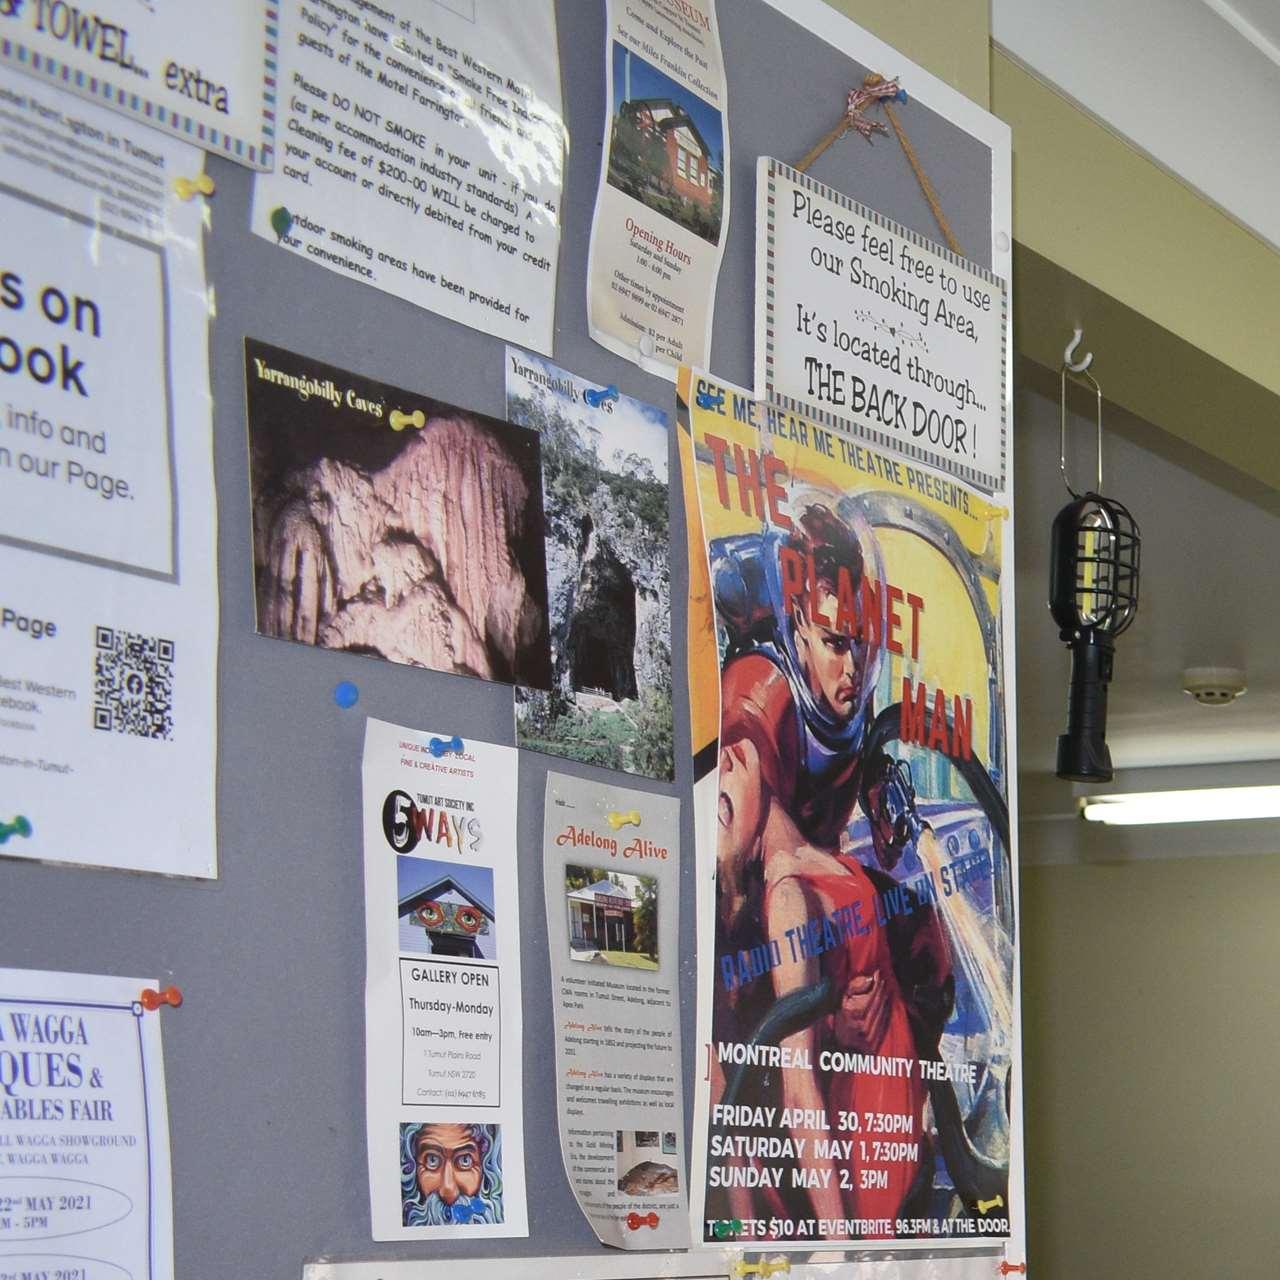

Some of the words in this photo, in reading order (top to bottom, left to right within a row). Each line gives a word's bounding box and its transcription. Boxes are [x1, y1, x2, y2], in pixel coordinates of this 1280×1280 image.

[166, 62, 229, 115] extra
[294, 72, 328, 101] Please
[332, 92, 350, 111] DO
[355, 104, 381, 126] NOT
[385, 121, 426, 149] SMOKE
[449, 153, 470, 169] your
[479, 168, 497, 183] unit
[285, 143, 310, 160] your
[315, 158, 356, 182] account
[362, 179, 374, 189] or
[378, 184, 420, 214] directly
[425, 205, 464, 231] debited
[469, 224, 492, 245] from
[496, 239, 517, 256] your
[523, 251, 551, 271] credit
[625, 218, 664, 252] Opening
[666, 239, 692, 265] Hours
[793, 190, 855, 244] Please
[862, 225, 894, 265] feel
[900, 246, 934, 283] free
[939, 268, 957, 295] to
[963, 284, 991, 312] use
[330, 230, 373, 259] smoking
[378, 250, 408, 272] areas
[412, 263, 436, 283] have
[440, 277, 464, 296] been
[469, 290, 510, 316] provided
[515, 308, 530, 324] for
[811, 247, 843, 275] our
[850, 256, 930, 326] Smoking
[935, 300, 979, 344] Area,
[41, 286, 101, 338] on
[511, 356, 581, 403] Yarrangobilly
[796, 303, 827, 343] It's
[834, 321, 901, 375] located
[907, 356, 986, 411] through...
[254, 358, 343, 408] Yarrangobilly
[346, 392, 383, 419] Caves
[805, 357, 845, 406] THE
[852, 375, 907, 431] BACK
[7, 404, 53, 439] info
[61, 425, 106, 454] and
[19, 453, 59, 479] our
[68, 460, 134, 501] Page.
[704, 432, 794, 532] THE
[767, 407, 808, 447] HEAR
[813, 428, 834, 458] ME
[839, 438, 903, 486] THEATRE
[907, 467, 978, 520] PRESENTS...
[778, 547, 926, 662] PLANET
[900, 676, 973, 762] MAN
[556, 826, 617, 857] Adelong
[623, 838, 667, 859] Alive
[720, 940, 782, 992] RADIO
[872, 886, 913, 927] LIVE
[412, 968, 457, 984] GALLERY
[461, 972, 489, 986] OPEN
[10, 1012, 88, 1046] WAGGA
[409, 998, 493, 1018] Thursday-Monday
[718, 1042, 812, 1070] MONTREAL
[820, 1051, 913, 1078] COMMUNITY
[919, 1059, 977, 1084] THEATRE
[71, 1100, 114, 1122] FAIR
[712, 1104, 776, 1128] FRIDAY
[779, 1108, 830, 1130] APRIL
[838, 1111, 862, 1133] 30,
[864, 1112, 913, 1135] 7:30PM
[16, 1135, 57, 1147] WAGGA
[59, 1135, 137, 1147] SHOWGROUND
[711, 1135, 805, 1159] SATURDAY
[814, 1140, 853, 1160] MAY
[860, 1142, 870, 1162] 1,
[872, 1142, 918, 1162] 7:30PM
[709, 1166, 783, 1188] SUNDAY
[792, 1168, 832, 1189] MAY
[839, 1169, 853, 1190] 2,
[860, 1170, 888, 1189] 3PM
[26, 1196, 55, 1211] MAY
[59, 1196, 92, 1210] 2021
[768, 1217, 793, 1238] $10
[797, 1219, 815, 1235] AT
[818, 1219, 895, 1237] EVENTBRITE,
[896, 1219, 931, 1234] 96.3FM
[932, 1219, 940, 1234] &
[940, 1218, 954, 1234] AT
[954, 1218, 975, 1233] THE
